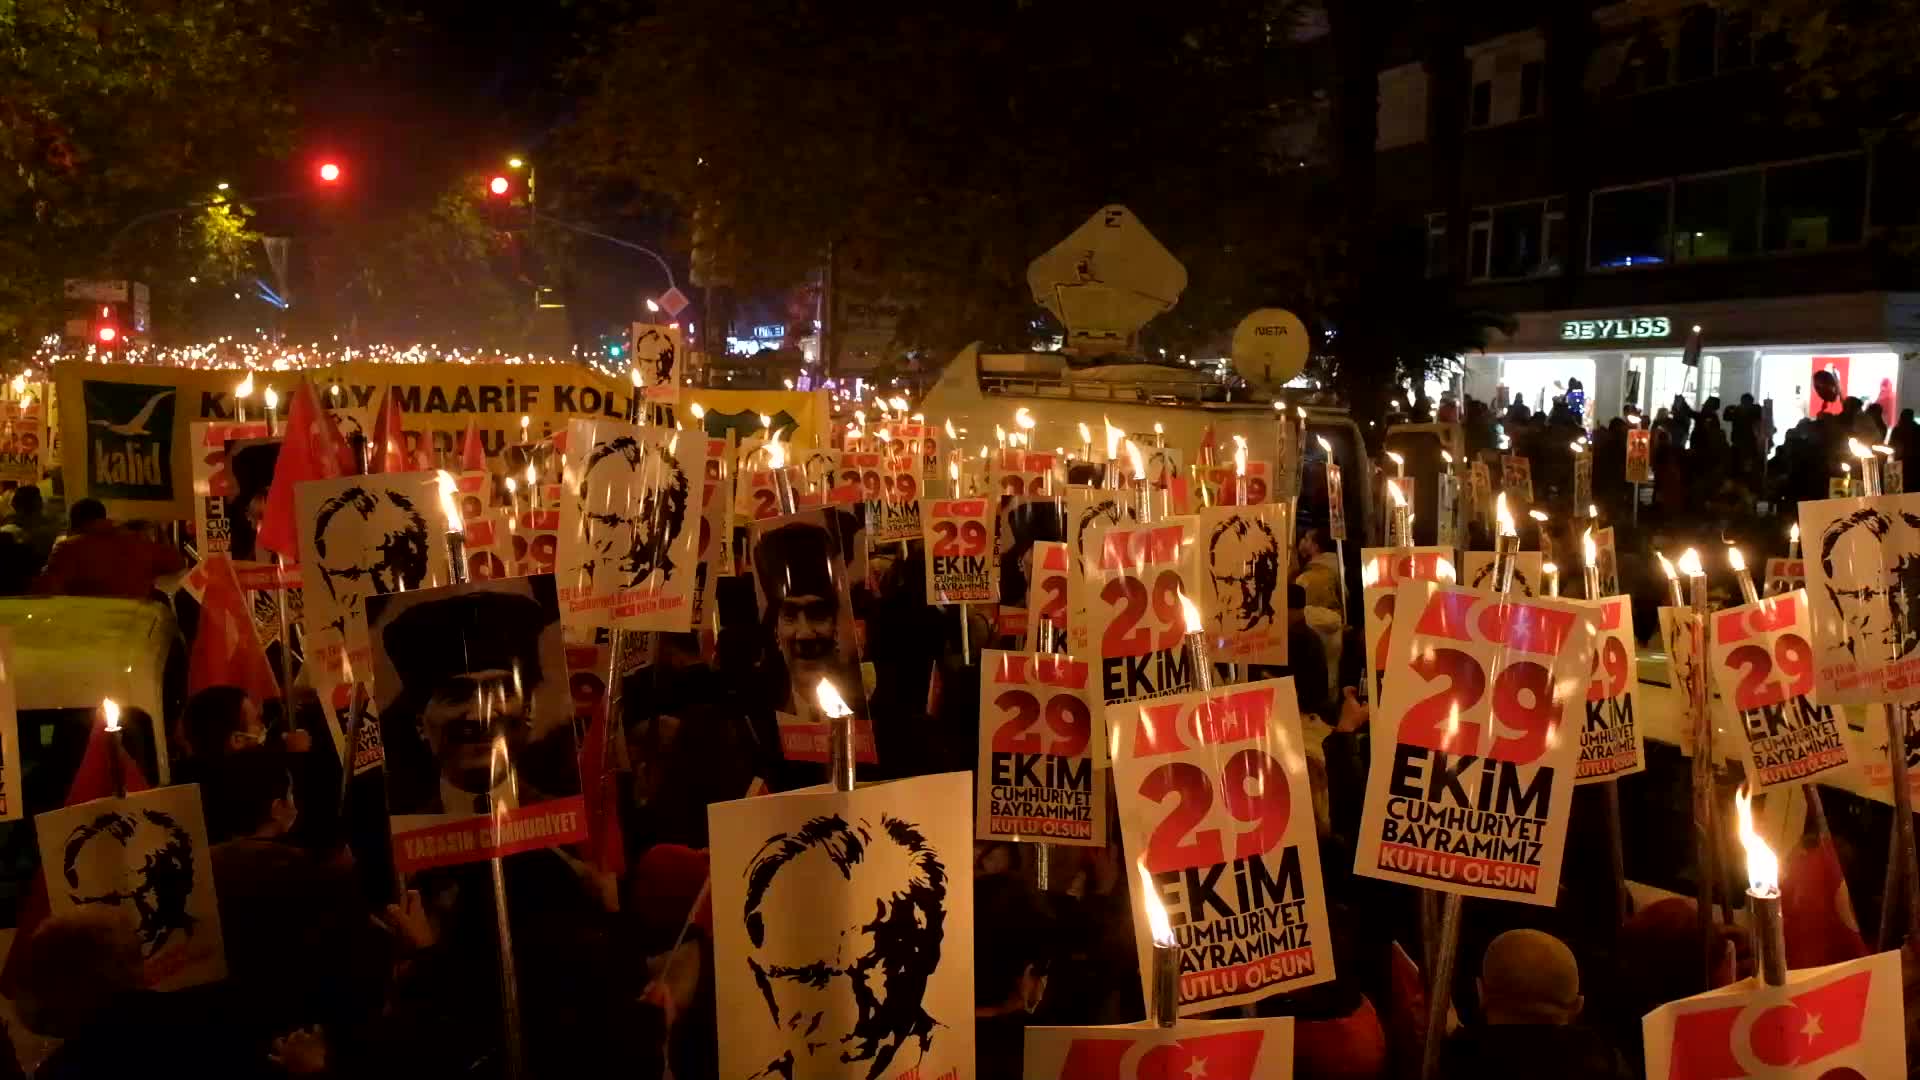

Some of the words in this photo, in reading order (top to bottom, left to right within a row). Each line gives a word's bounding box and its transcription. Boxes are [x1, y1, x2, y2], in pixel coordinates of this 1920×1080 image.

[1560, 317, 1671, 339] BEYLISS
[392, 379, 539, 413] MAARİF
[932, 520, 987, 557] 29
[1101, 569, 1185, 656] 29
[1725, 633, 1814, 712] 29
[991, 690, 1092, 757] 29
[1397, 648, 1565, 767] 29
[991, 801, 1092, 821] BAYRAMIMIZ
[992, 819, 1038, 834] KUTLU
[1042, 820, 1090, 838] OLSUN
[1138, 748, 1291, 873] 29
[1386, 797, 1547, 843] CUMHURİYET
[1381, 818, 1544, 866] BAYRAMIMIZ
[1381, 845, 1457, 879] KUTLU
[1463, 861, 1538, 891] OLSUN
[1173, 899, 1306, 950] UMHURİYET
[1179, 923, 1312, 974] AYRAMIMIZ
[1244, 951, 1313, 988] OLSUN
